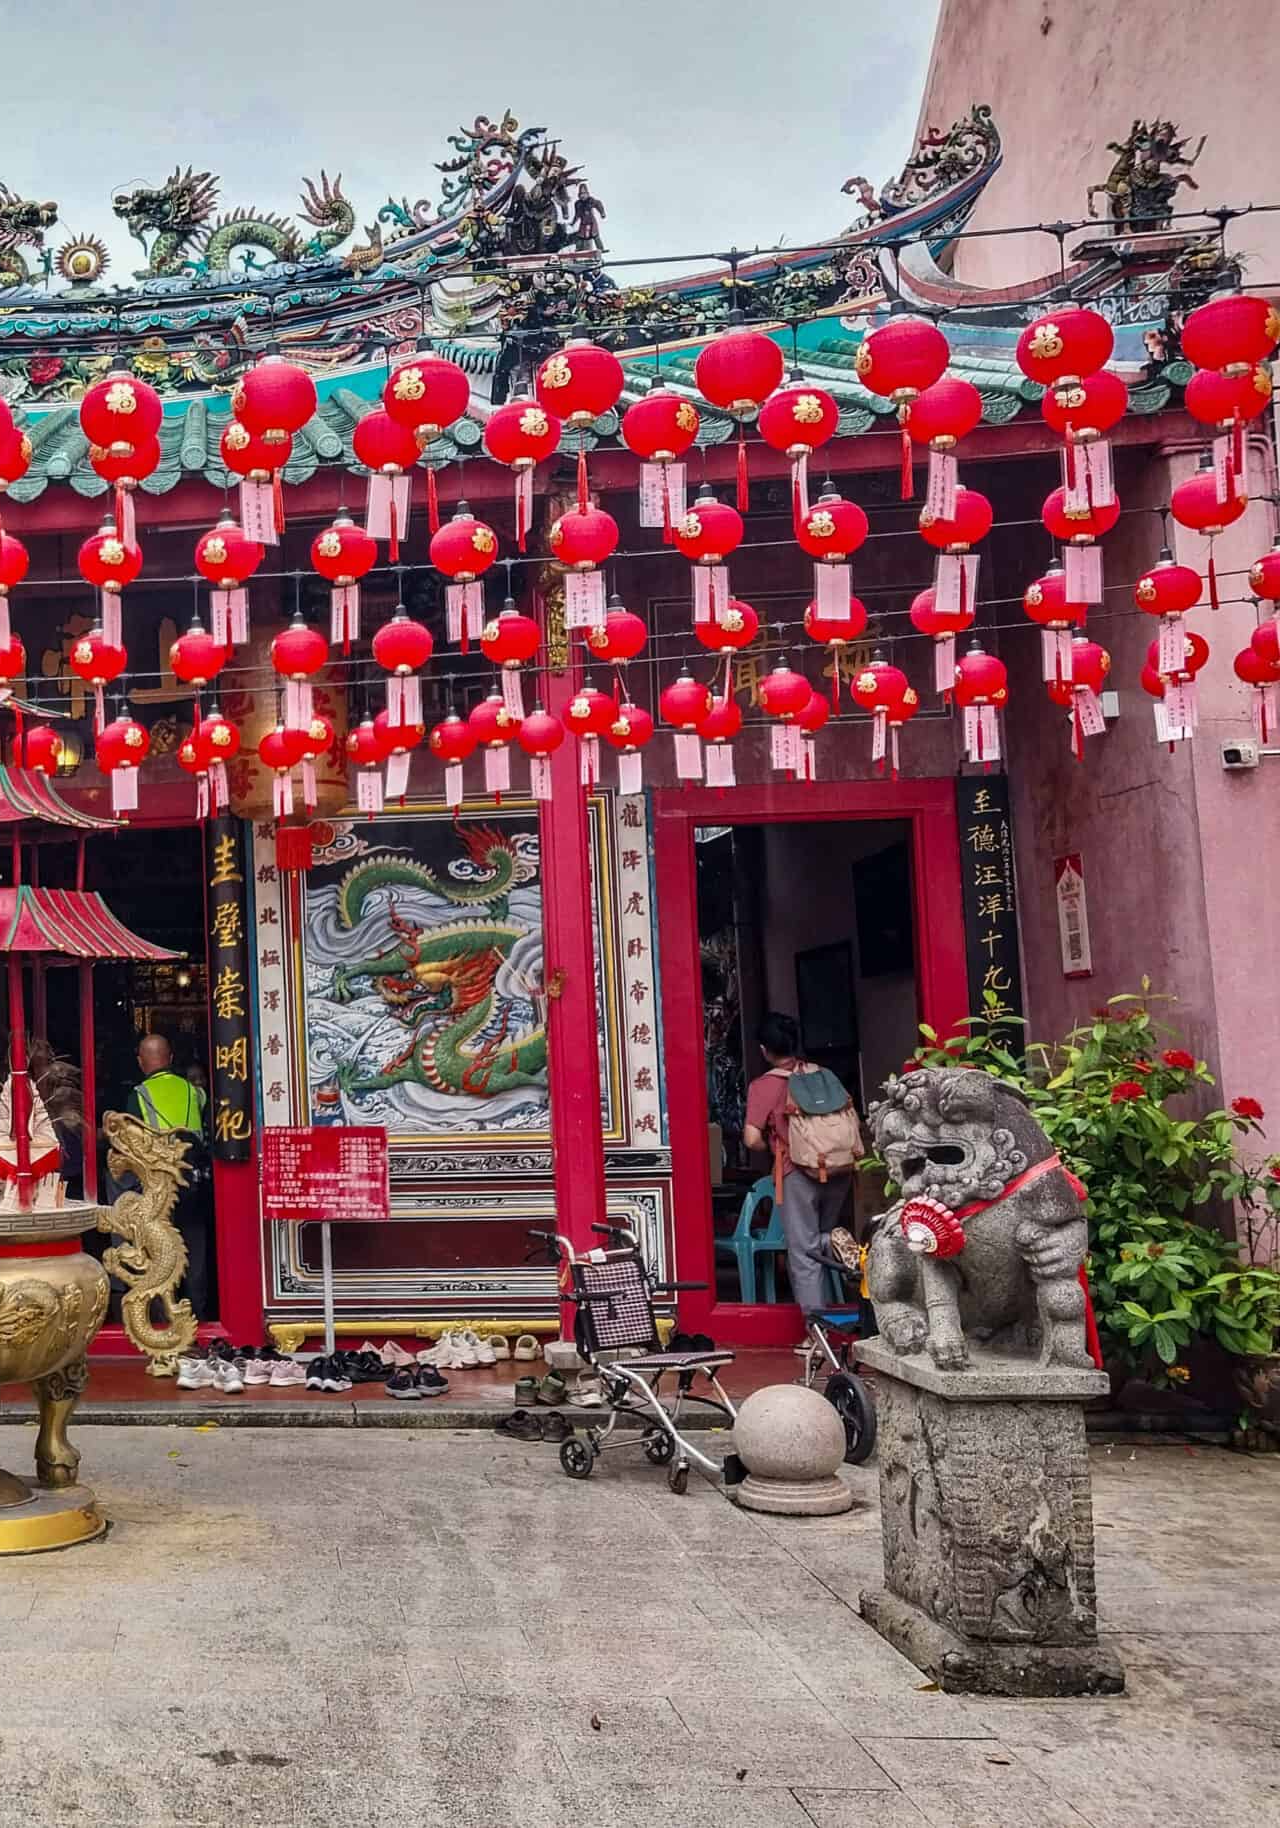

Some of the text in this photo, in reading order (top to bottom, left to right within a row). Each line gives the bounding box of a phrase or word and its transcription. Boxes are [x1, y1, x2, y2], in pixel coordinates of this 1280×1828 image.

[1029, 324, 1064, 359] 福
[393, 368, 426, 401] 福
[542, 355, 572, 389] 福
[105, 383, 137, 414] 福
[792, 395, 824, 423] 福
[520, 407, 549, 437] 福
[675, 401, 699, 433] 福
[807, 511, 836, 537] 福
[98, 538, 126, 565] 福
